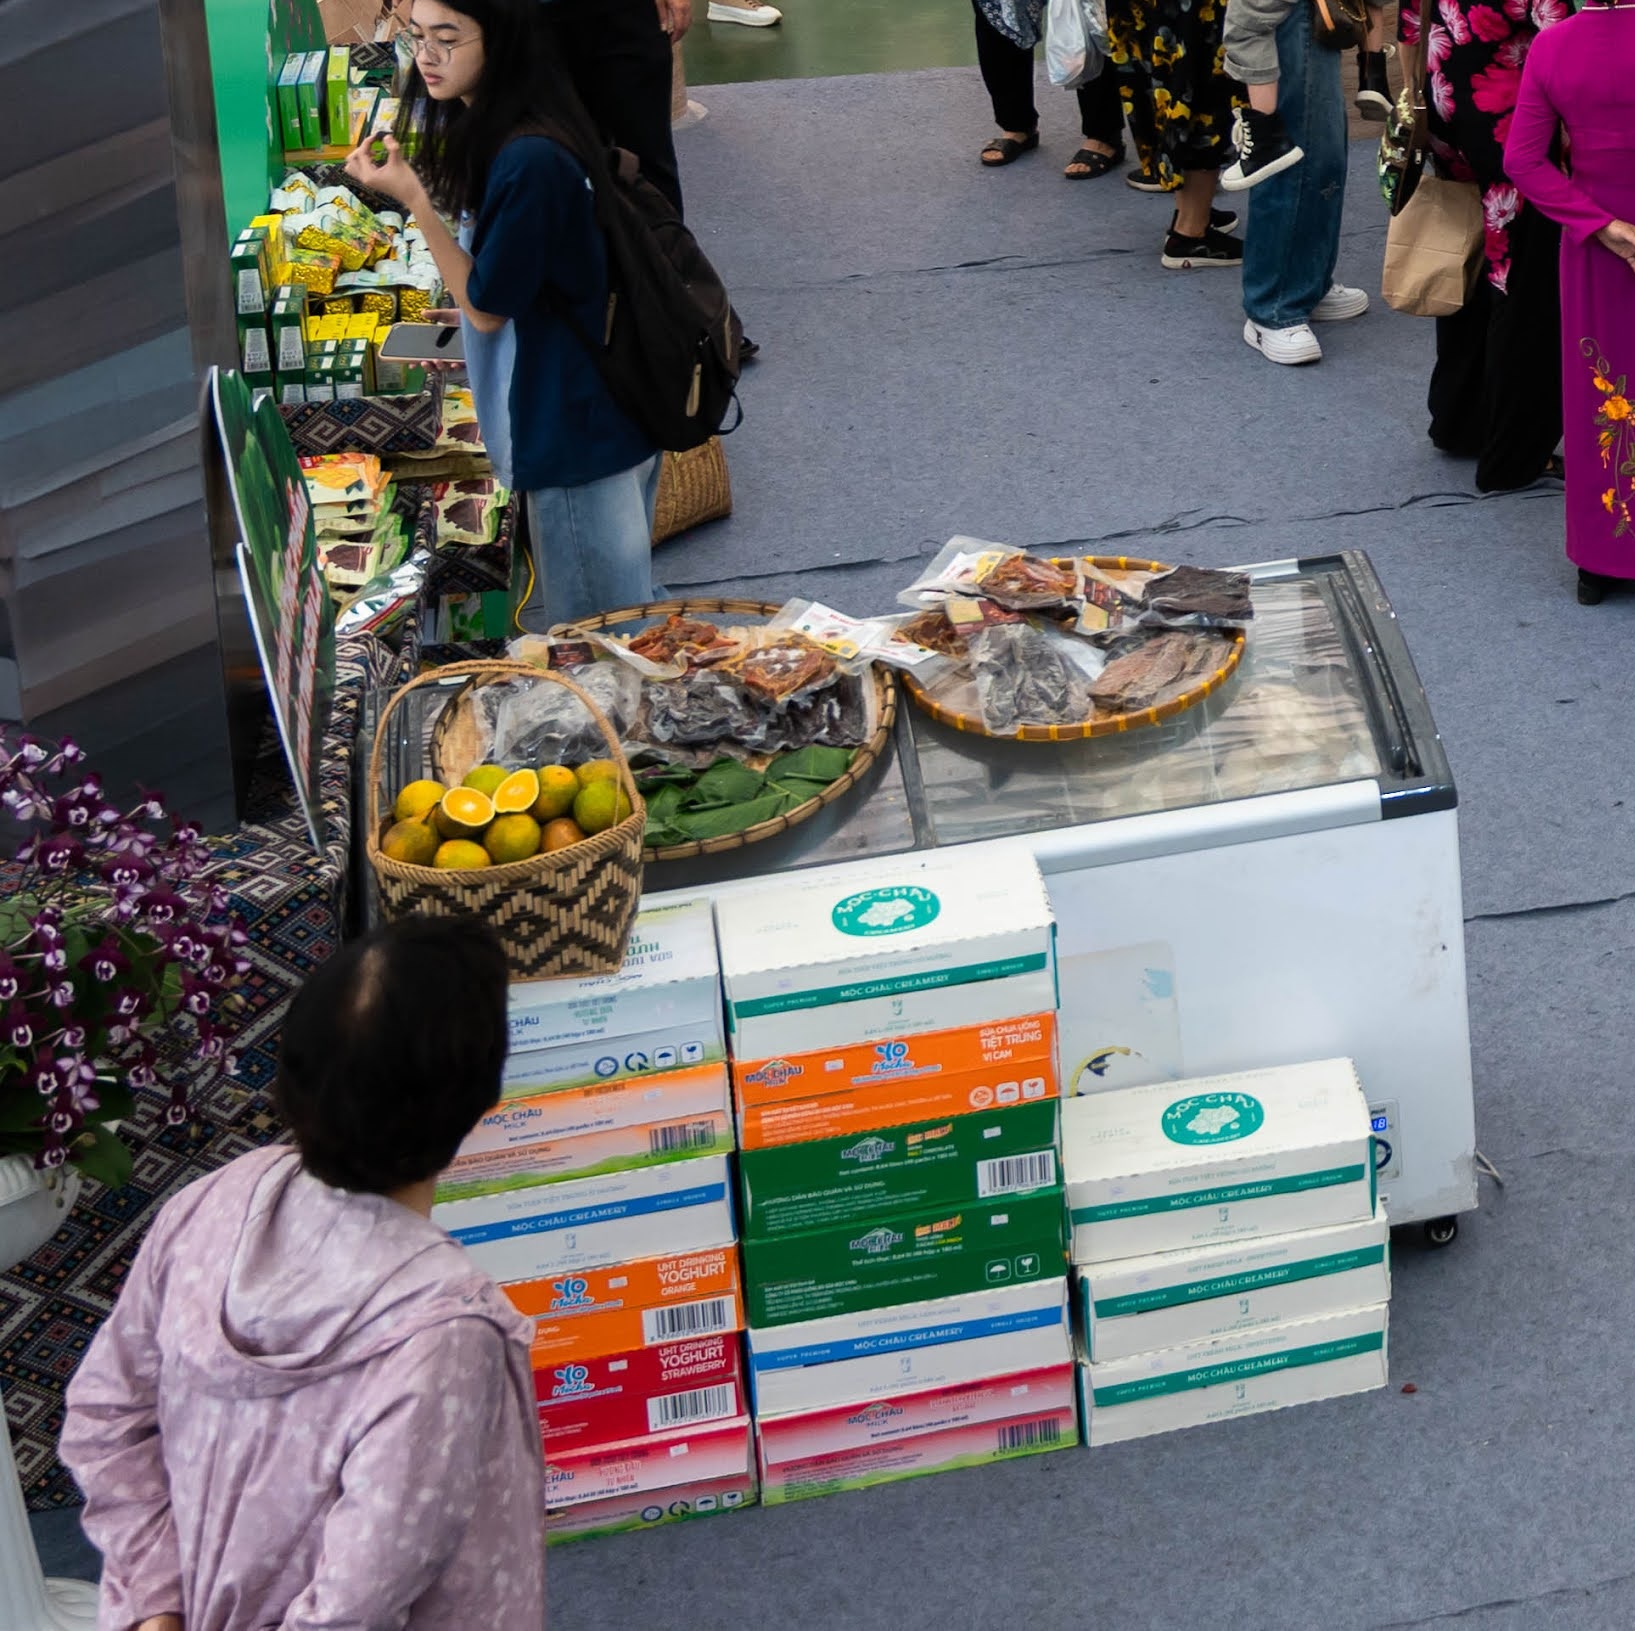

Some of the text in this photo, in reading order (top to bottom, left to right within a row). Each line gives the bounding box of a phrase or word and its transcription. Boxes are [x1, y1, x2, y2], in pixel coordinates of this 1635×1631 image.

[894, 974, 950, 990] CREAMERY
[1170, 1195, 1192, 1207] MỘC
[1222, 1183, 1274, 1200] CREAMERY
[512, 1221, 536, 1234] MỘC
[568, 1205, 628, 1223] CREAMERY
[657, 1252, 726, 1273] UHT DRINKING
[658, 1262, 726, 1285] YOGHURT
[661, 1282, 697, 1296] ORANGE
[1188, 1284, 1210, 1297] MỘC
[1238, 1269, 1291, 1287] CREAMERY
[908, 1326, 965, 1343] CREAMERY
[659, 1336, 724, 1358] UHT DRINKING
[660, 1347, 724, 1368] YOGHURT
[661, 1359, 727, 1382] STRAWBERRY
[1187, 1370, 1209, 1383] MỘC
[1238, 1356, 1289, 1373] CREAMERY
